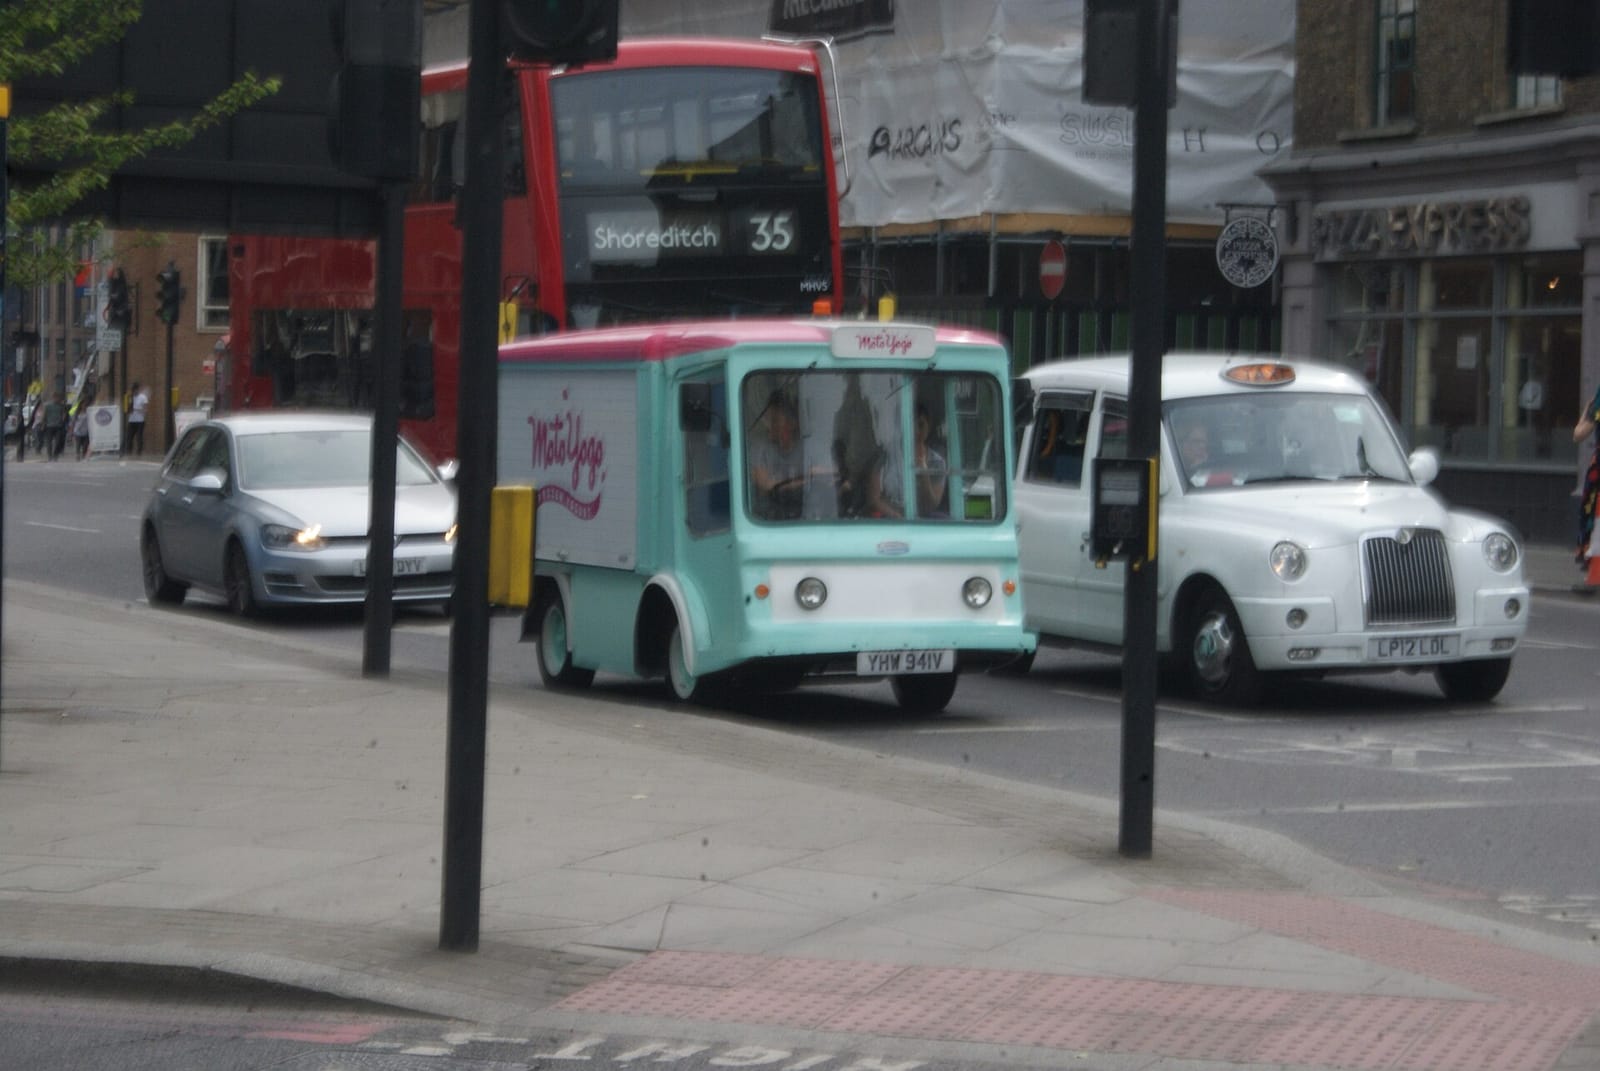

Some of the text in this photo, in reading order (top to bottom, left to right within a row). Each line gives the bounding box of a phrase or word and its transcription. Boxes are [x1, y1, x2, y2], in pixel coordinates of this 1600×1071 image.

[594, 216, 792, 251] Shoreditch 35
[1378, 639, 1416, 657] LP12
[868, 652, 943, 672] YHW 941V
